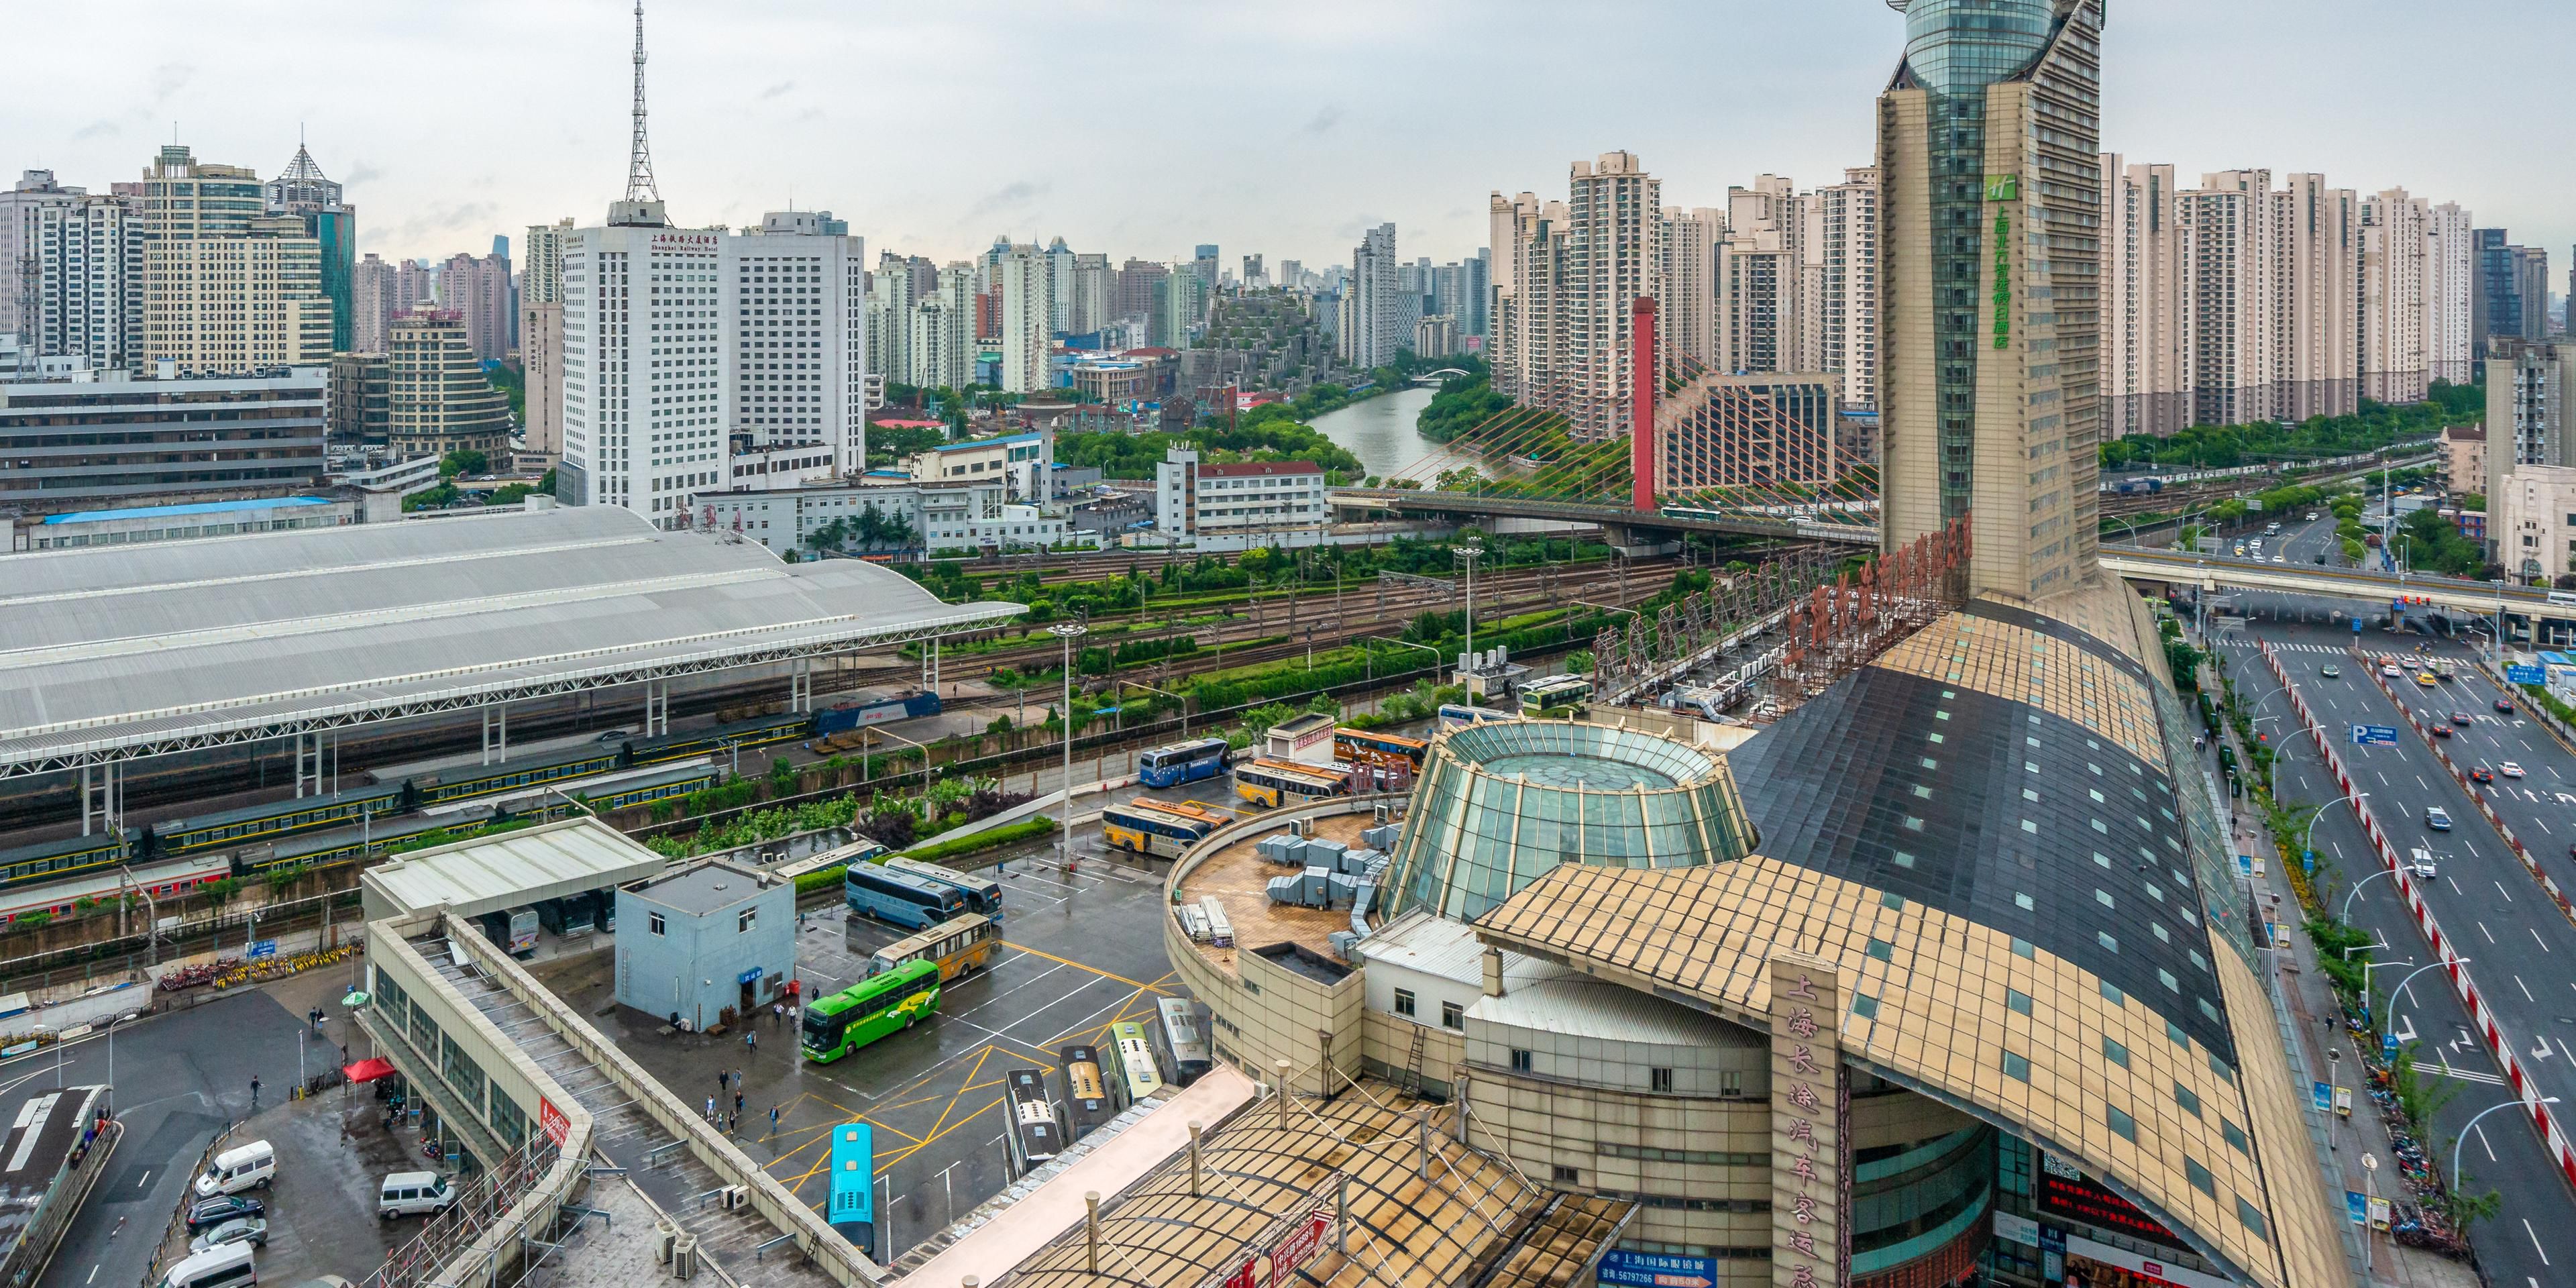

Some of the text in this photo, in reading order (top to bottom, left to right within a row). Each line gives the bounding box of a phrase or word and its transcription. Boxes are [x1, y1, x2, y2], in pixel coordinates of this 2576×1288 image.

[651, 233, 718, 245] 上海铁路大厦酒店
[1993, 205, 2010, 350] 上海北方智选假日酒店
[2353, 725, 2368, 743] P
[1277, 1225, 1315, 1266] 中兴路1688号
[1622, 1253, 1705, 1271] 上海国际眼镜城
[1658, 1275, 1700, 1287] 向前50米
